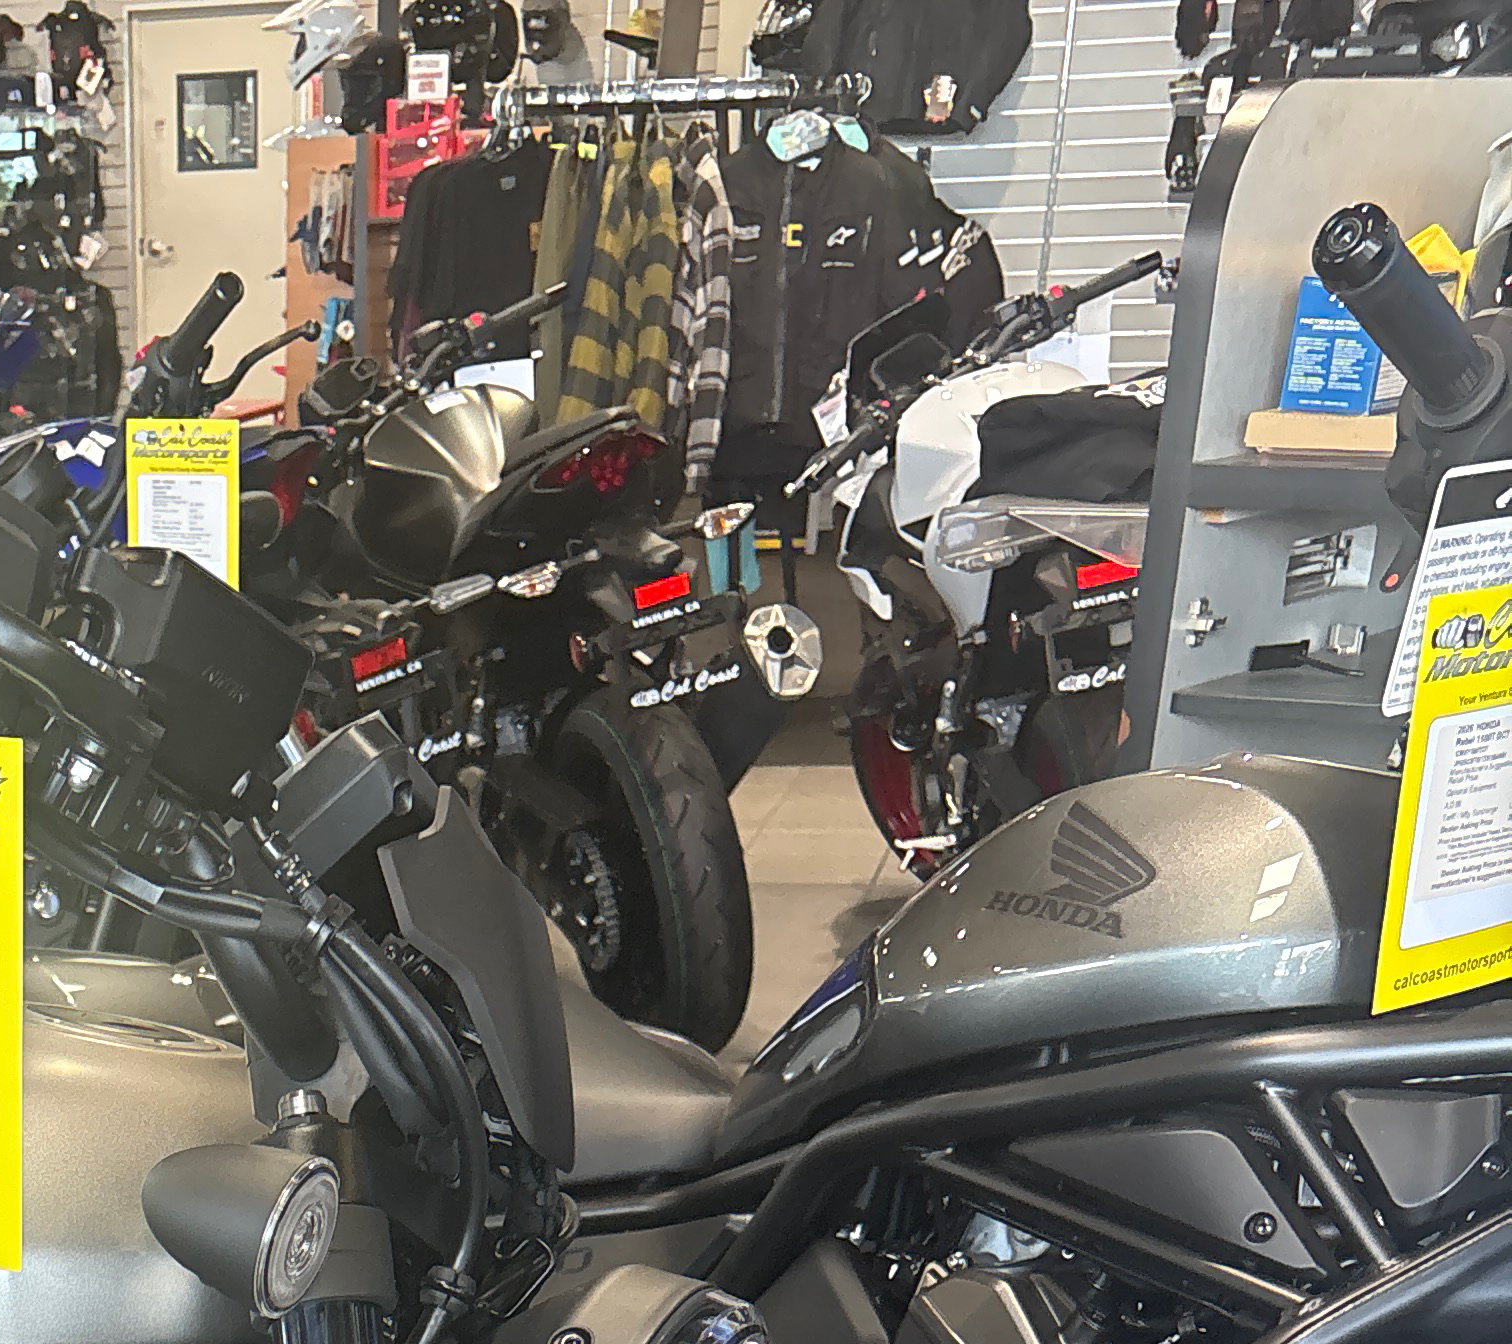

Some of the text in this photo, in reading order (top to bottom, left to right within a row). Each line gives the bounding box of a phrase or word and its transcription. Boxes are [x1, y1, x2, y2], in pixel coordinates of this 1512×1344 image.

[661, 663, 741, 702] Cal Coast
[1092, 663, 1127, 688] Cal
[418, 731, 462, 762] Coast
[983, 888, 1125, 939] HONDA
